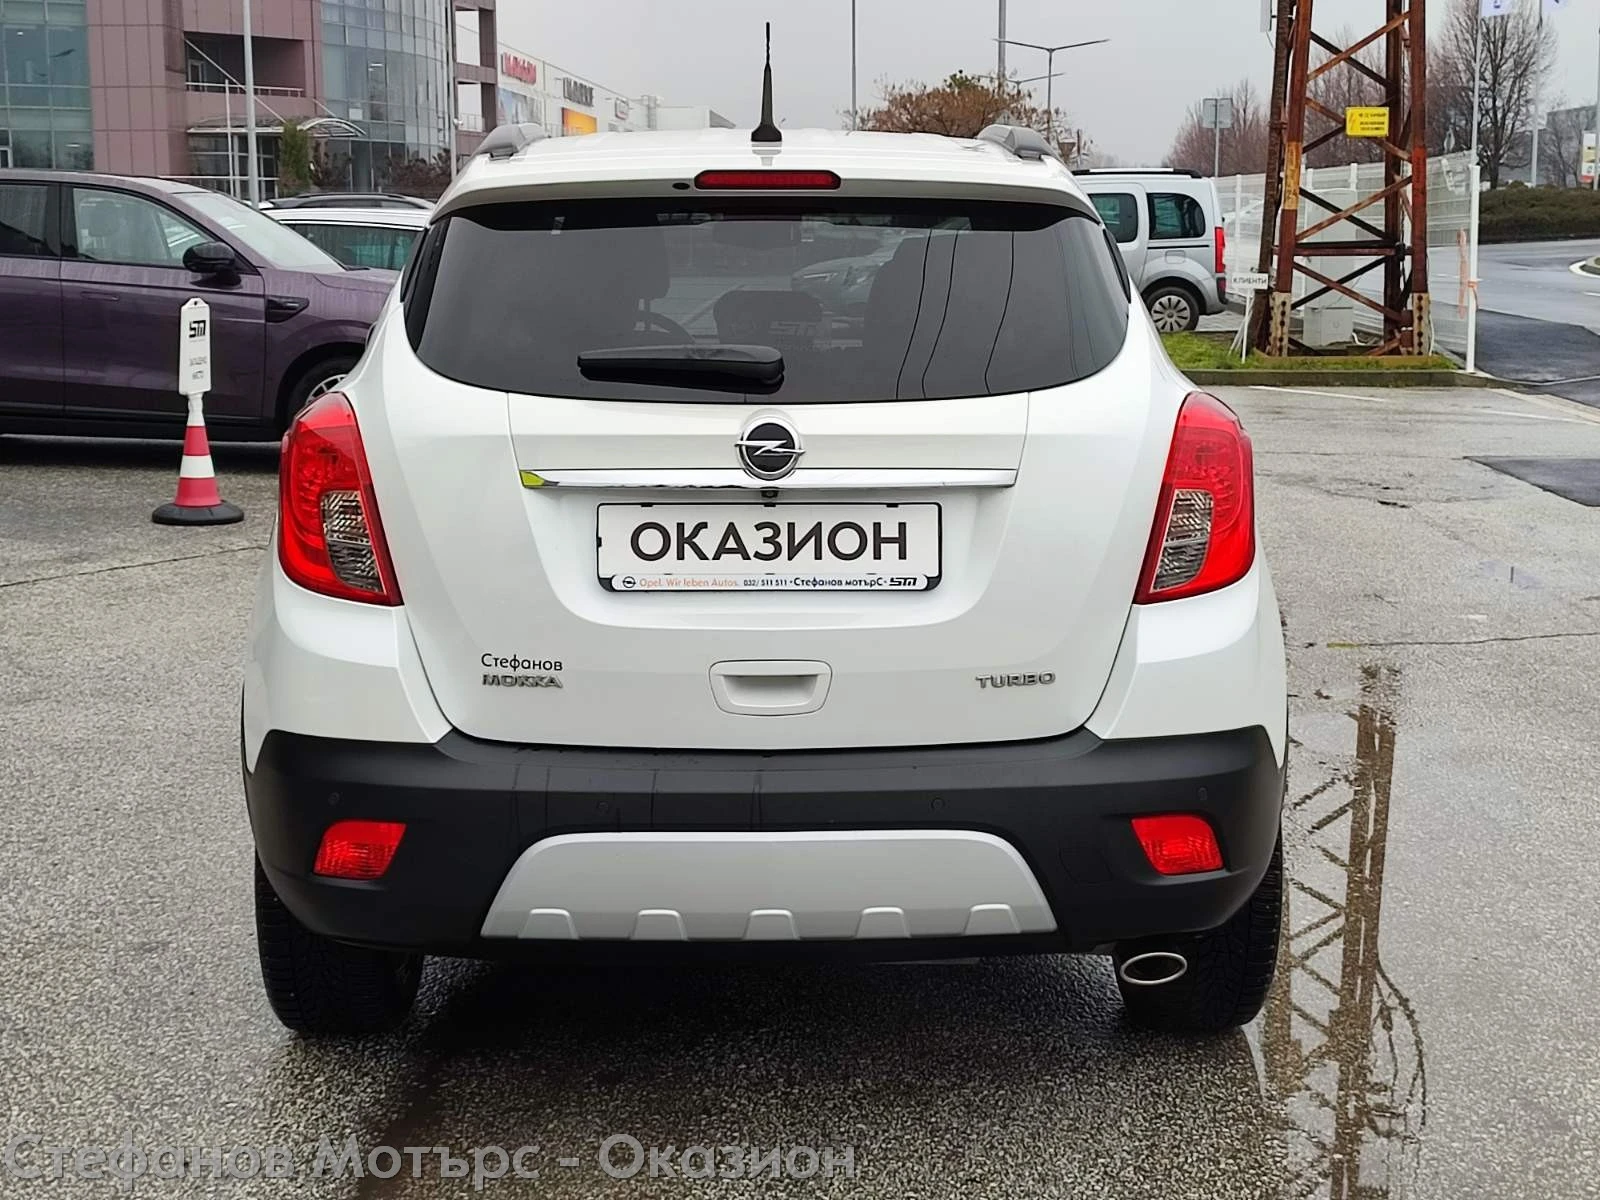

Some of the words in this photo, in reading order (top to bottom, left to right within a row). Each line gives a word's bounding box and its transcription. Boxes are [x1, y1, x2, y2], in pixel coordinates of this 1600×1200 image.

[630, 521, 907, 562] ОКАЗИОН
[666, 578, 681, 587] Wir
[683, 577, 709, 587] leben
[761, 577, 773, 587] 511
[775, 577, 788, 587] 511
[481, 653, 563, 672] Стефанов
[482, 674, 563, 688] MOKKA
[975, 671, 1056, 689] TURBO
